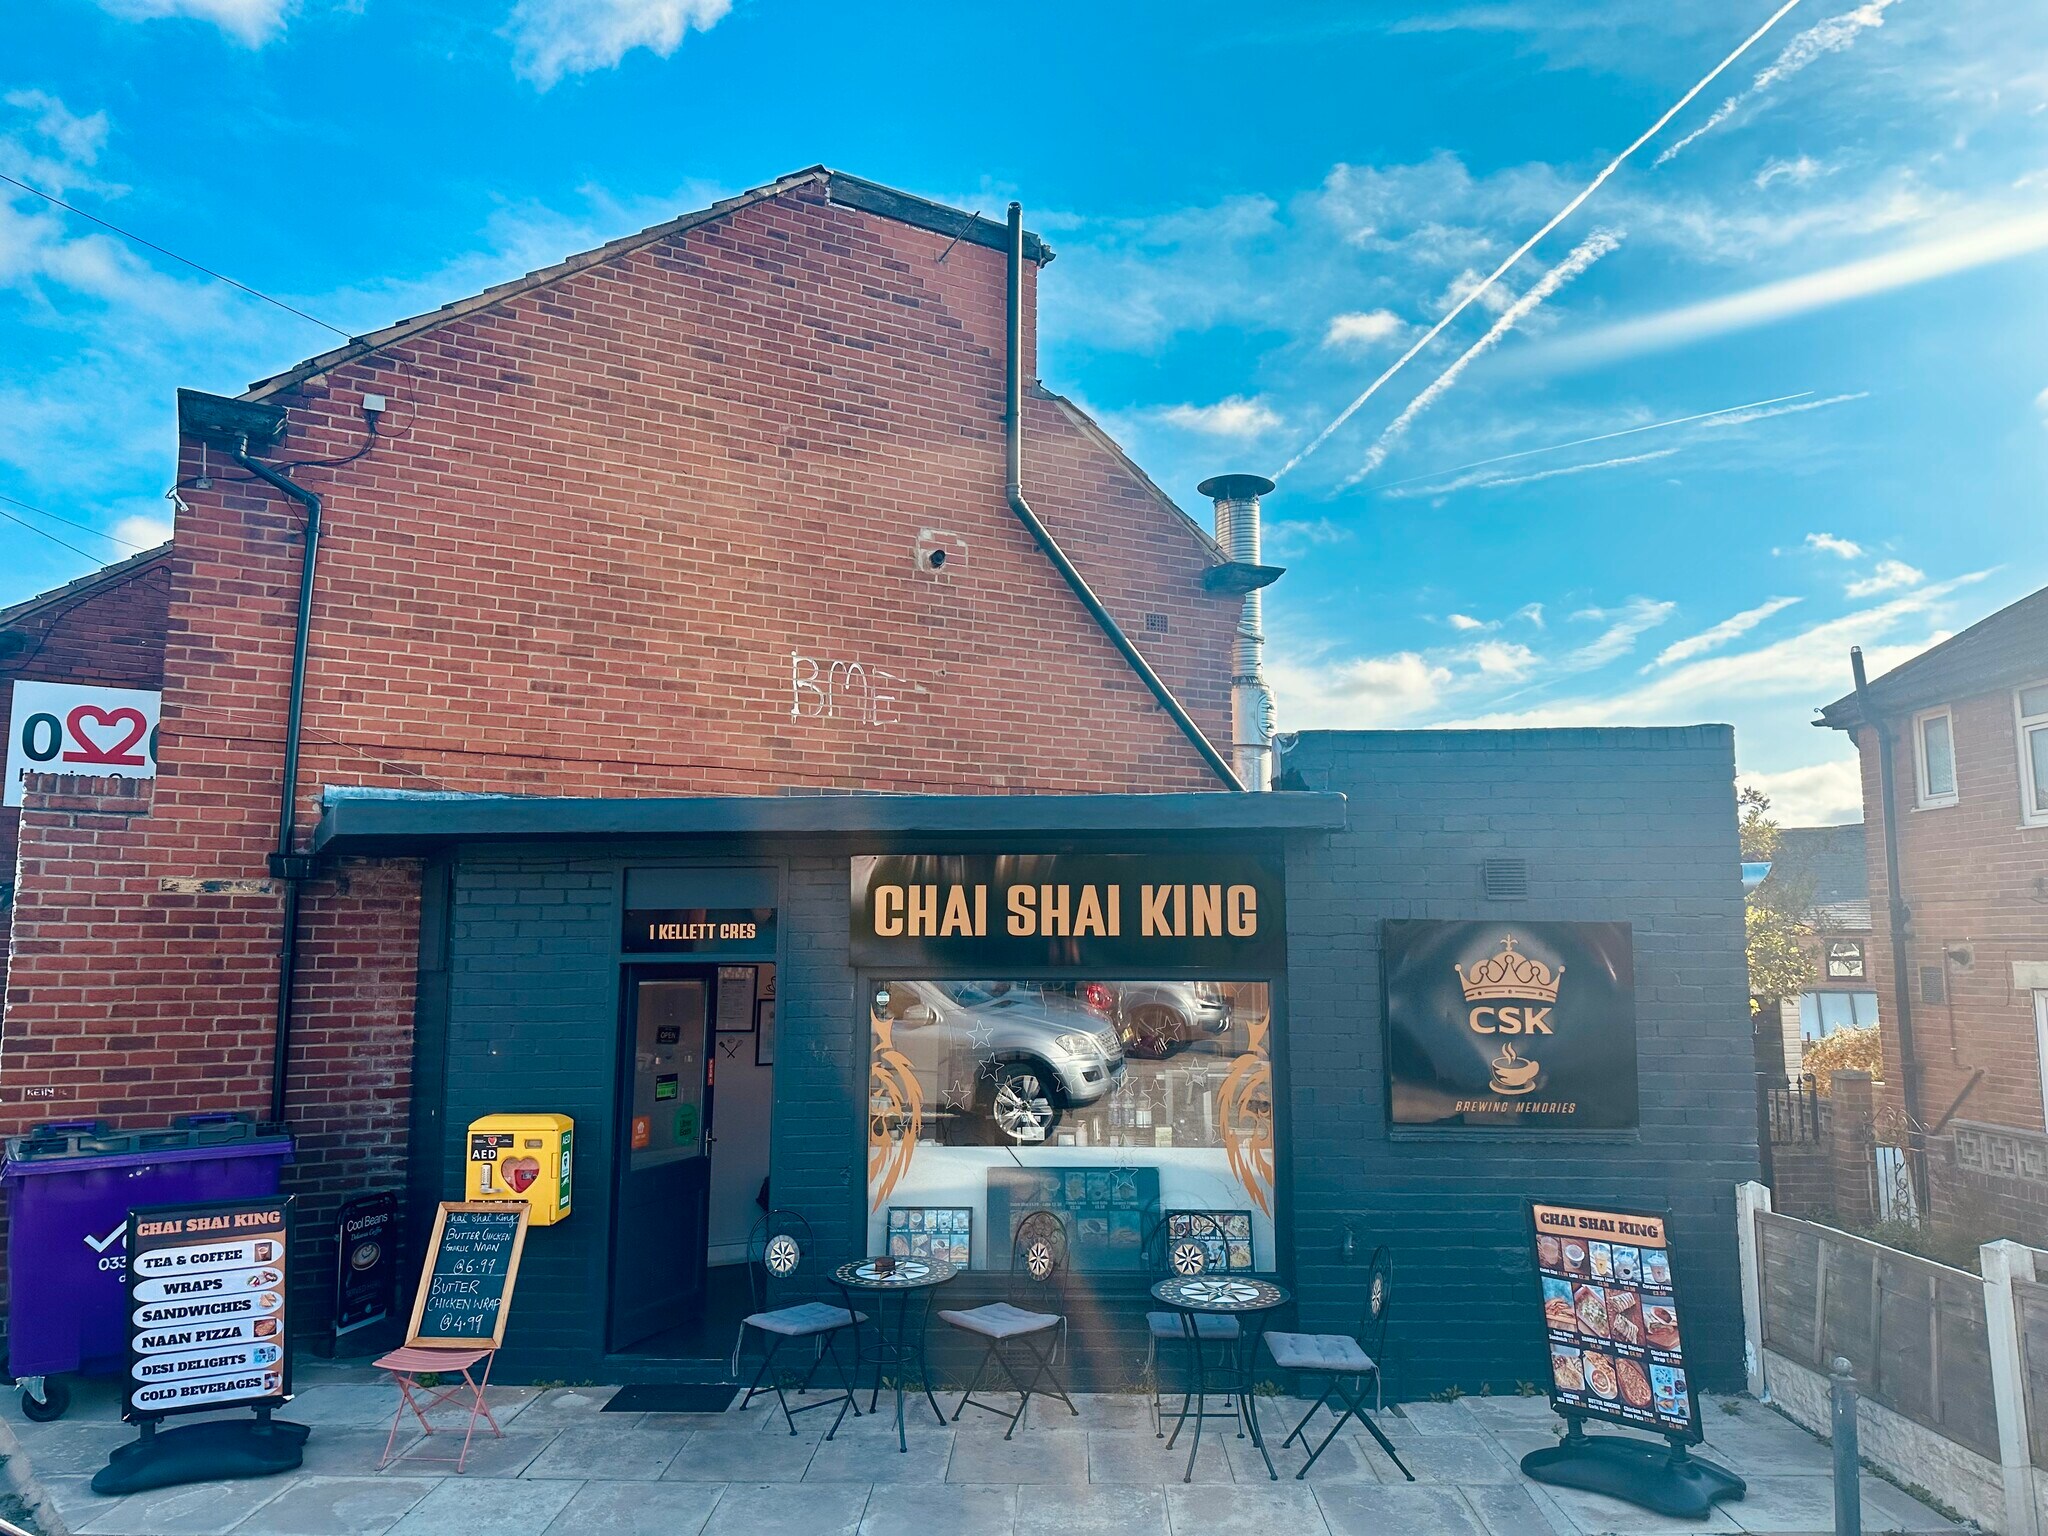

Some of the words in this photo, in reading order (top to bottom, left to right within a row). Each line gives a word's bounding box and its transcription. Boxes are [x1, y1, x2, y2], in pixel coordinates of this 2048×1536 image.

[790, 650, 906, 726] BME
[874, 884, 987, 937] CHAI
[1006, 884, 1120, 937] SHAI
[1141, 884, 1258, 937] KING
[659, 923, 716, 940] KELLETT
[720, 923, 756, 939] CRES
[1469, 1006, 1554, 1035] CSK
[660, 1031, 676, 1039] OPEN
[1455, 1100, 1509, 1112] BREWING
[1515, 1102, 1577, 1114] MEMORIES
[472, 1149, 497, 1160] AED
[136, 1220, 182, 1237] CHAI
[186, 1215, 230, 1232] SHAI
[234, 1211, 281, 1228] KING
[346, 1217, 364, 1232] Cool
[364, 1213, 388, 1227] Beans
[1540, 1212, 1576, 1228] CHAI
[1578, 1216, 1615, 1233] SHAI
[1619, 1221, 1659, 1238] KING
[144, 1257, 173, 1269] TEA
[176, 1255, 187, 1265] &
[190, 1249, 243, 1264] COFFEE
[163, 1278, 223, 1295] WRAPS
[432, 1276, 480, 1295] BUTTER
[142, 1299, 252, 1322] SANDWICHES
[427, 1296, 472, 1312] CHICKEN
[473, 1296, 502, 1311] WRAP
[142, 1332, 191, 1348] NAAN
[195, 1326, 242, 1342] PIZZA
[142, 1364, 174, 1376] DESI
[177, 1354, 247, 1371] DELIGHTS
[140, 1388, 177, 1402] COLD
[180, 1377, 262, 1397] BEVERAGES
